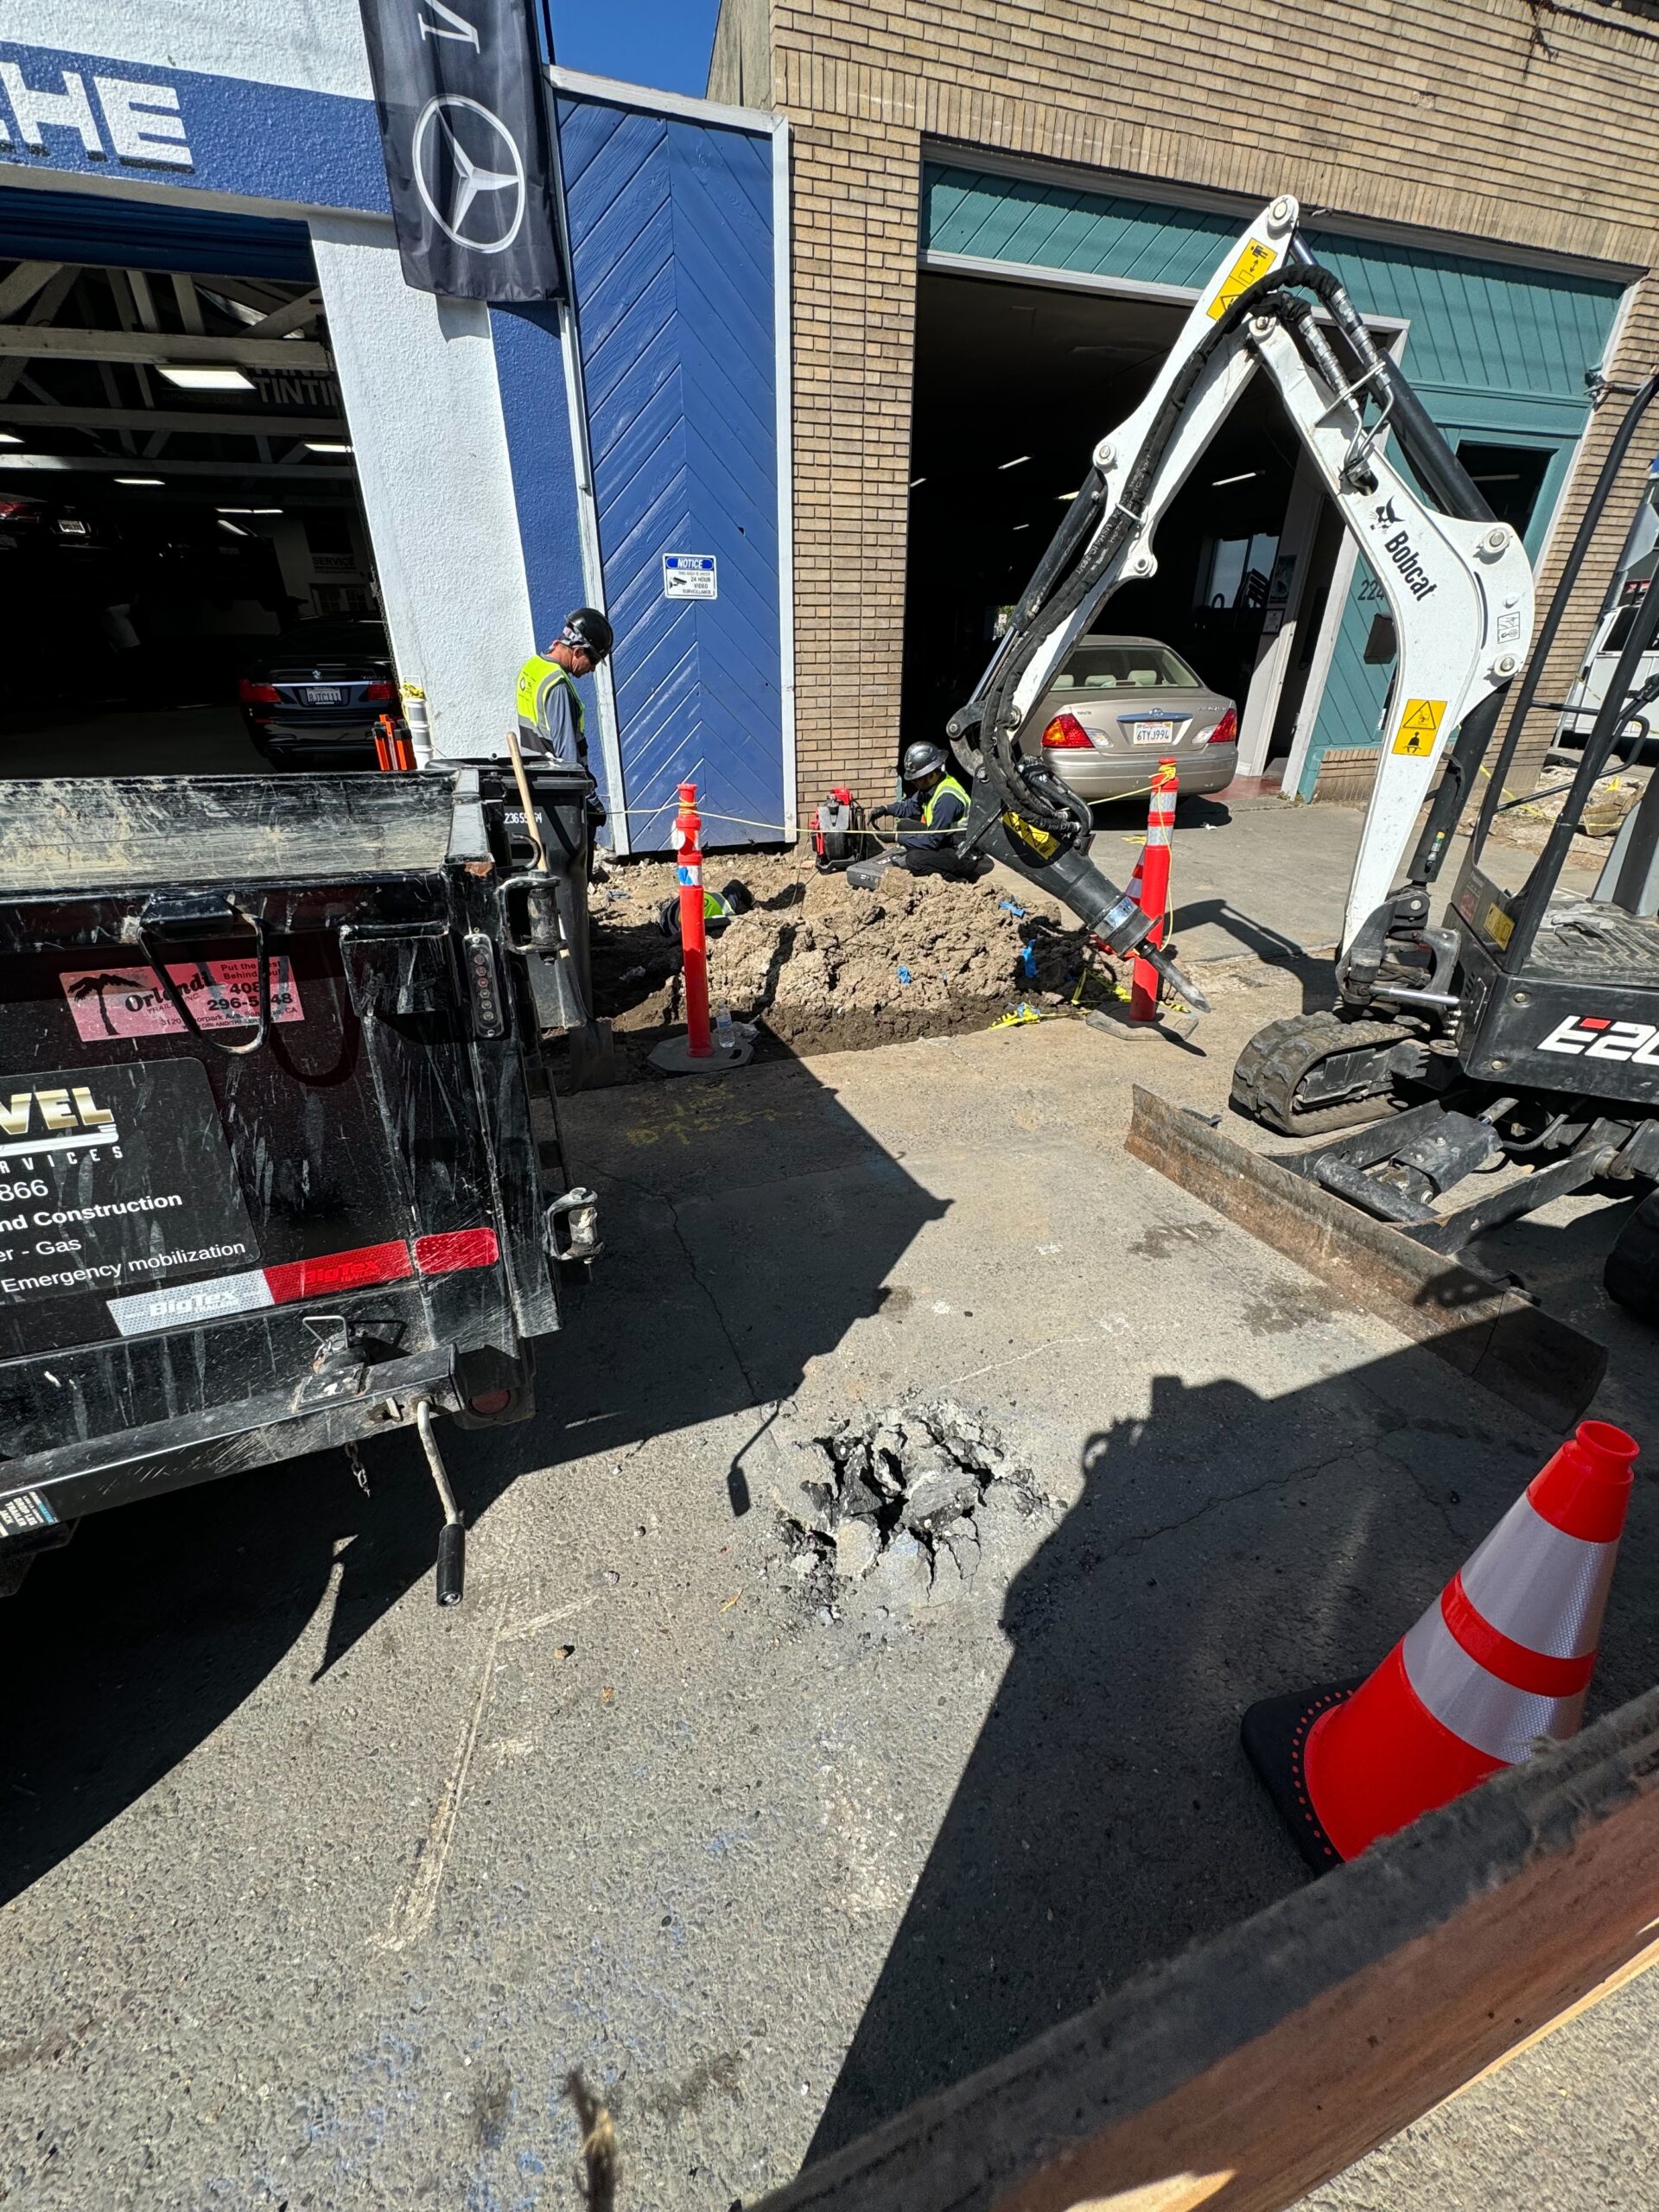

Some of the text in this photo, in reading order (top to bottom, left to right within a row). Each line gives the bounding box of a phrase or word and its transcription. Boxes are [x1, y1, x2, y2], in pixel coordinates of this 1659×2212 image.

[0, 61, 193, 165] HE
[312, 556, 356, 567] SERVICE
[677, 558, 703, 569] NOTICE
[1384, 530, 1438, 602] Bobcat
[1357, 579, 1384, 601] 224
[223, 971, 257, 980] Behind
[230, 982, 260, 995] 408
[207, 993, 292, 1011] 296-548
[162, 1017, 181, 1026] 3120
[33, 1193, 183, 1226] Construction
[35, 1239, 82, 1255] Gas
[1, 1242, 246, 1293] Emergency mobilization
[0, 1510, 15, 1525] JACK
[4, 1501, 27, 1527] TRAILER
[13, 1497, 38, 1526] DROP LEG
